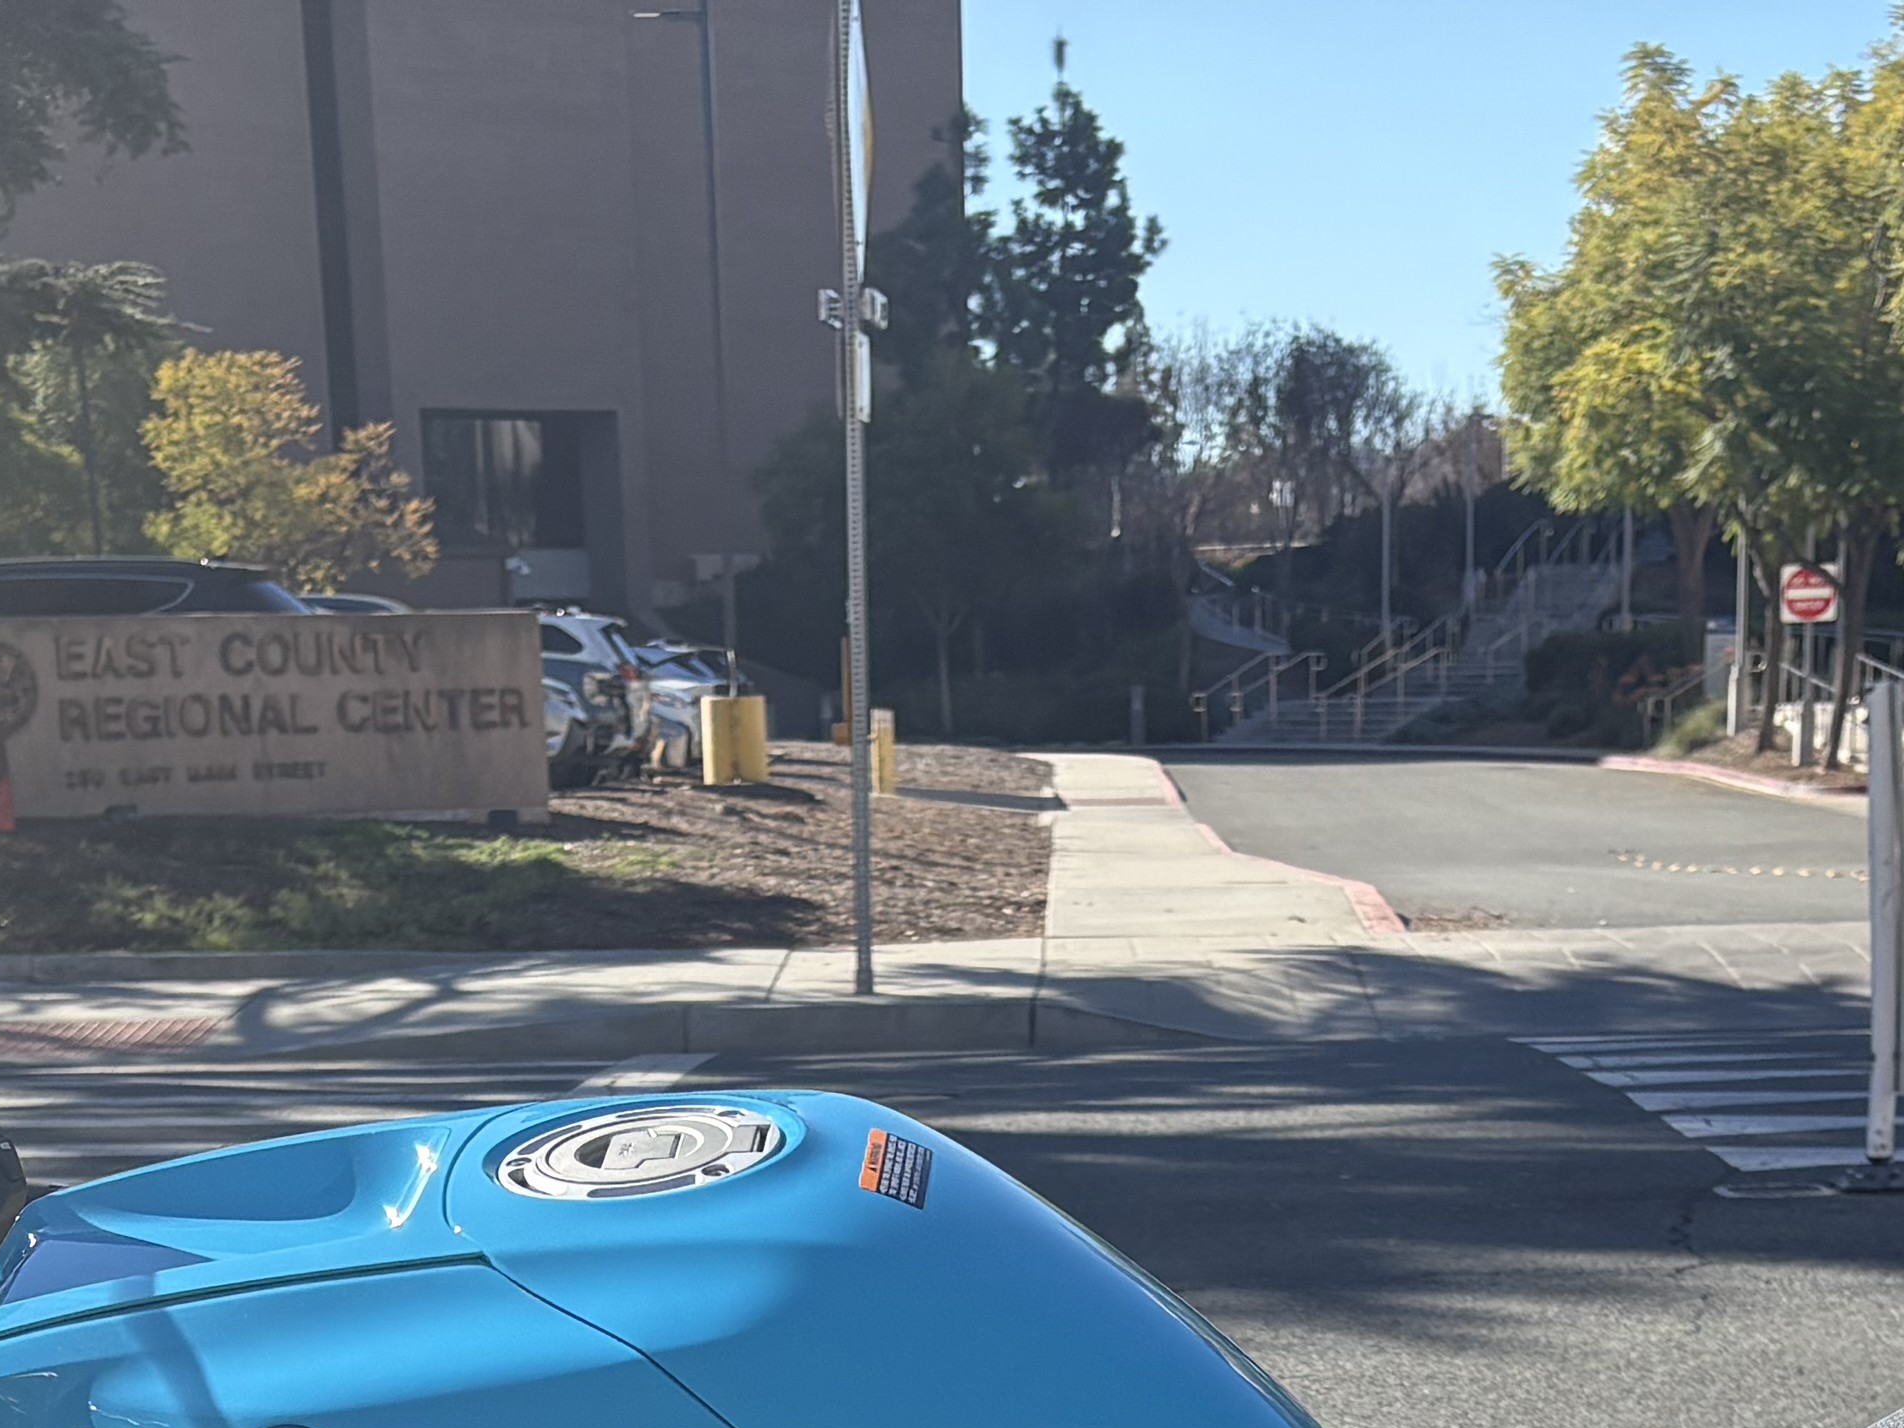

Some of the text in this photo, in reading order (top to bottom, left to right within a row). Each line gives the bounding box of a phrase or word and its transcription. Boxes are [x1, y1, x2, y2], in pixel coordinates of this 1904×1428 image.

[55, 630, 428, 681] EAST COUNTY
[58, 687, 531, 742] REGIONAL CENTER
